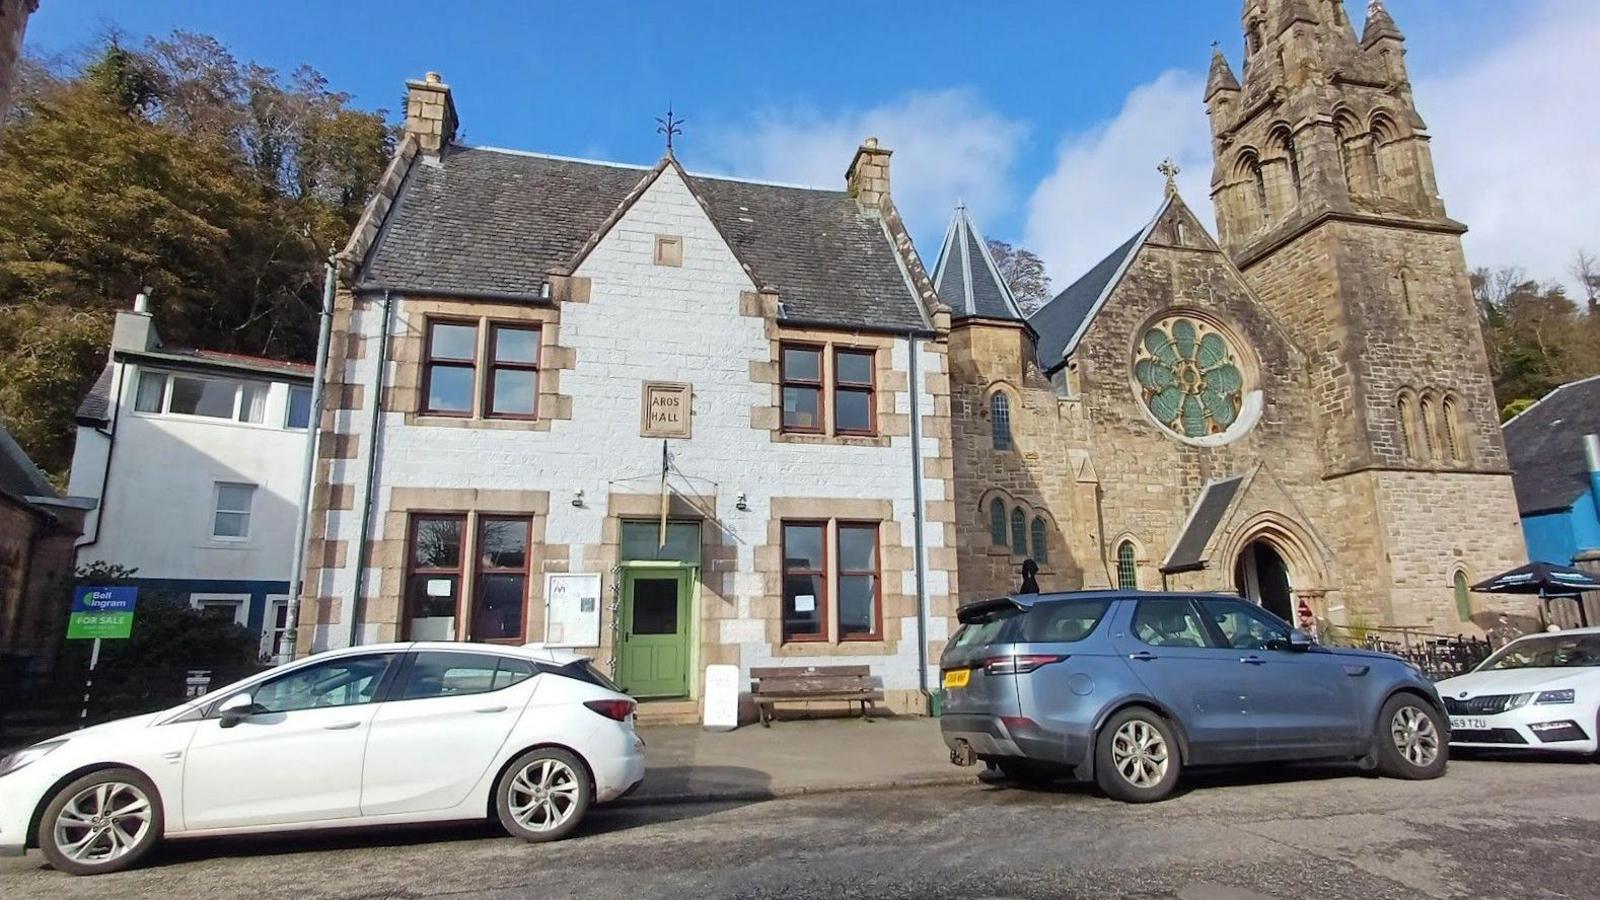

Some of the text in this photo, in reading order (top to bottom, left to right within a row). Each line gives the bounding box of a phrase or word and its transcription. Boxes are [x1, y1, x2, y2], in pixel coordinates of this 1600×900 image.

[652, 397, 679, 407] AROS
[652, 412, 679, 422] HALL
[92, 591, 112, 599] Bell
[90, 599, 126, 608] Ingram
[77, 616, 125, 624] FOR SALE
[1467, 719, 1486, 728] TZU
